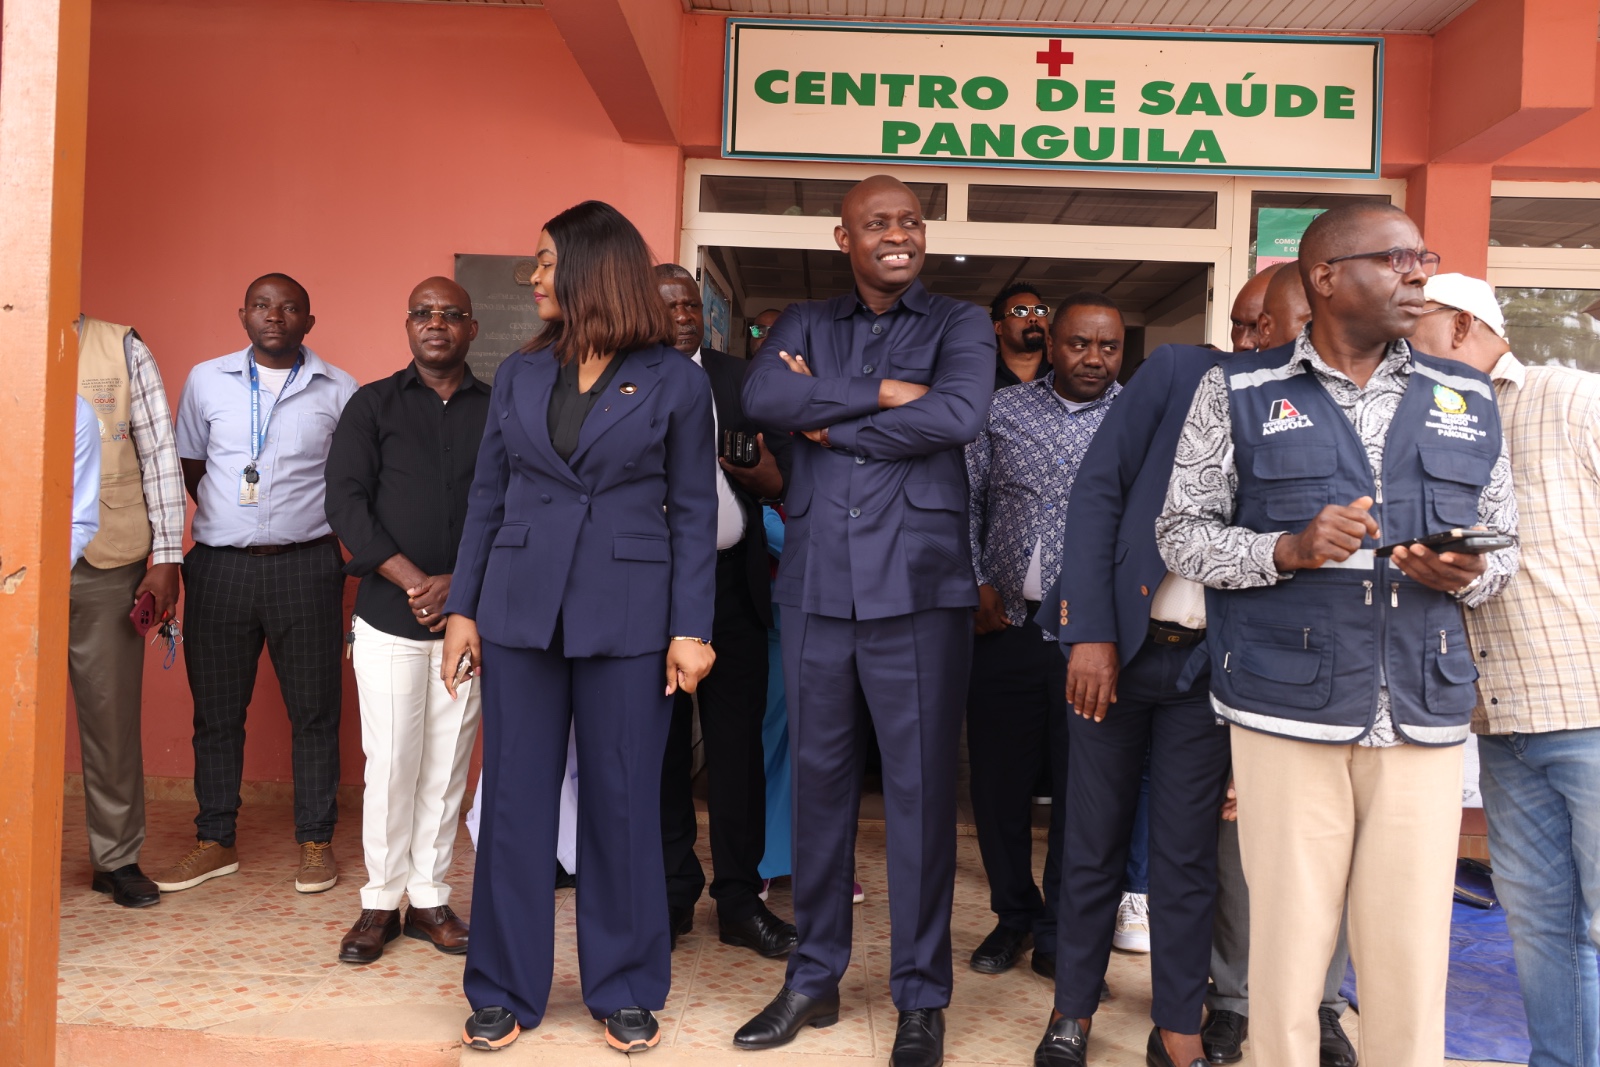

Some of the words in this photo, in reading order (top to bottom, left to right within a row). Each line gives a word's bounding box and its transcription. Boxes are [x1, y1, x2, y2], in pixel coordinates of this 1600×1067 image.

[754, 69, 1009, 111] CENTRO
[1036, 78, 1116, 114] DE
[1138, 71, 1356, 120] SAÚDE
[881, 120, 1228, 164] PANGUILA
[1262, 418, 1314, 436] ANGOLA
